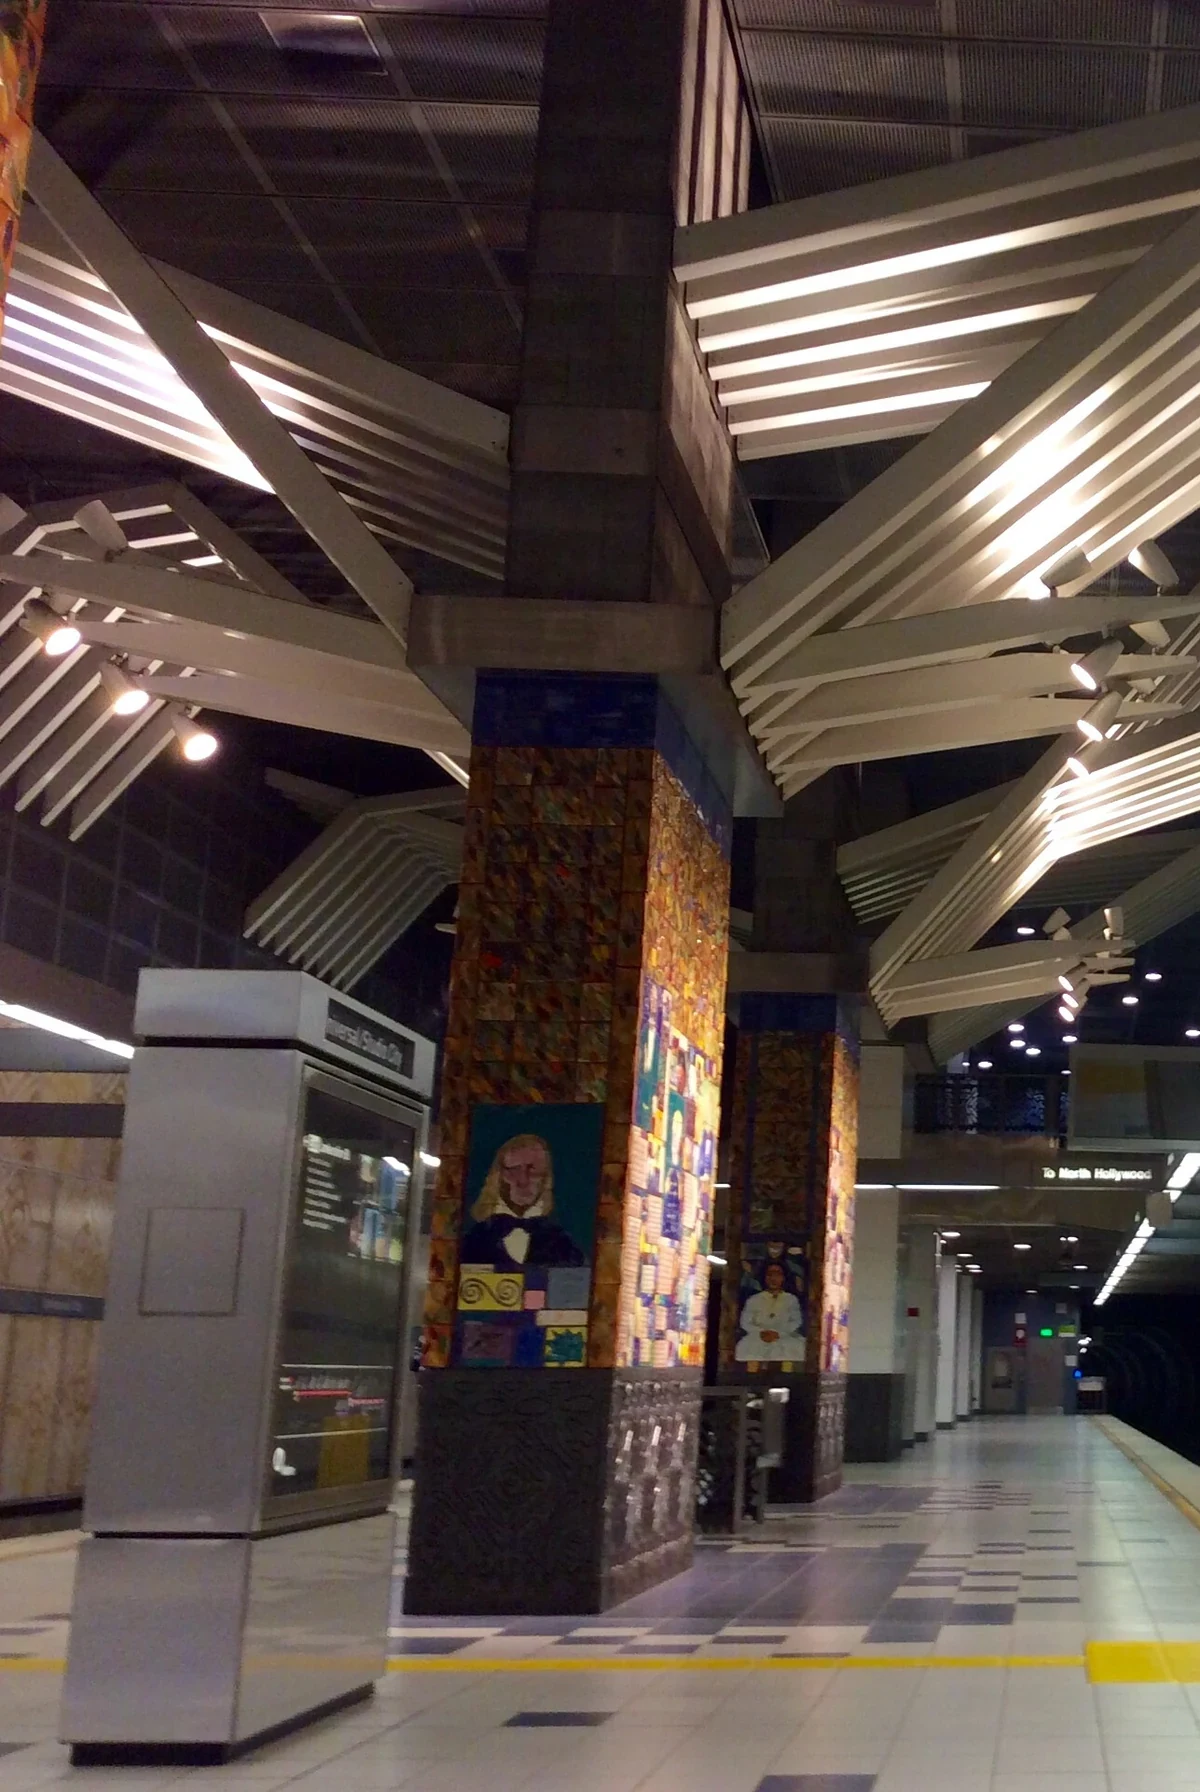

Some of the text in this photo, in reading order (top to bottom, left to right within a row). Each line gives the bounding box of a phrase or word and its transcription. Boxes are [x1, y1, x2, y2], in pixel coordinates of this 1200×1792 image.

[1042, 1167, 1152, 1181] To North Hollywood
